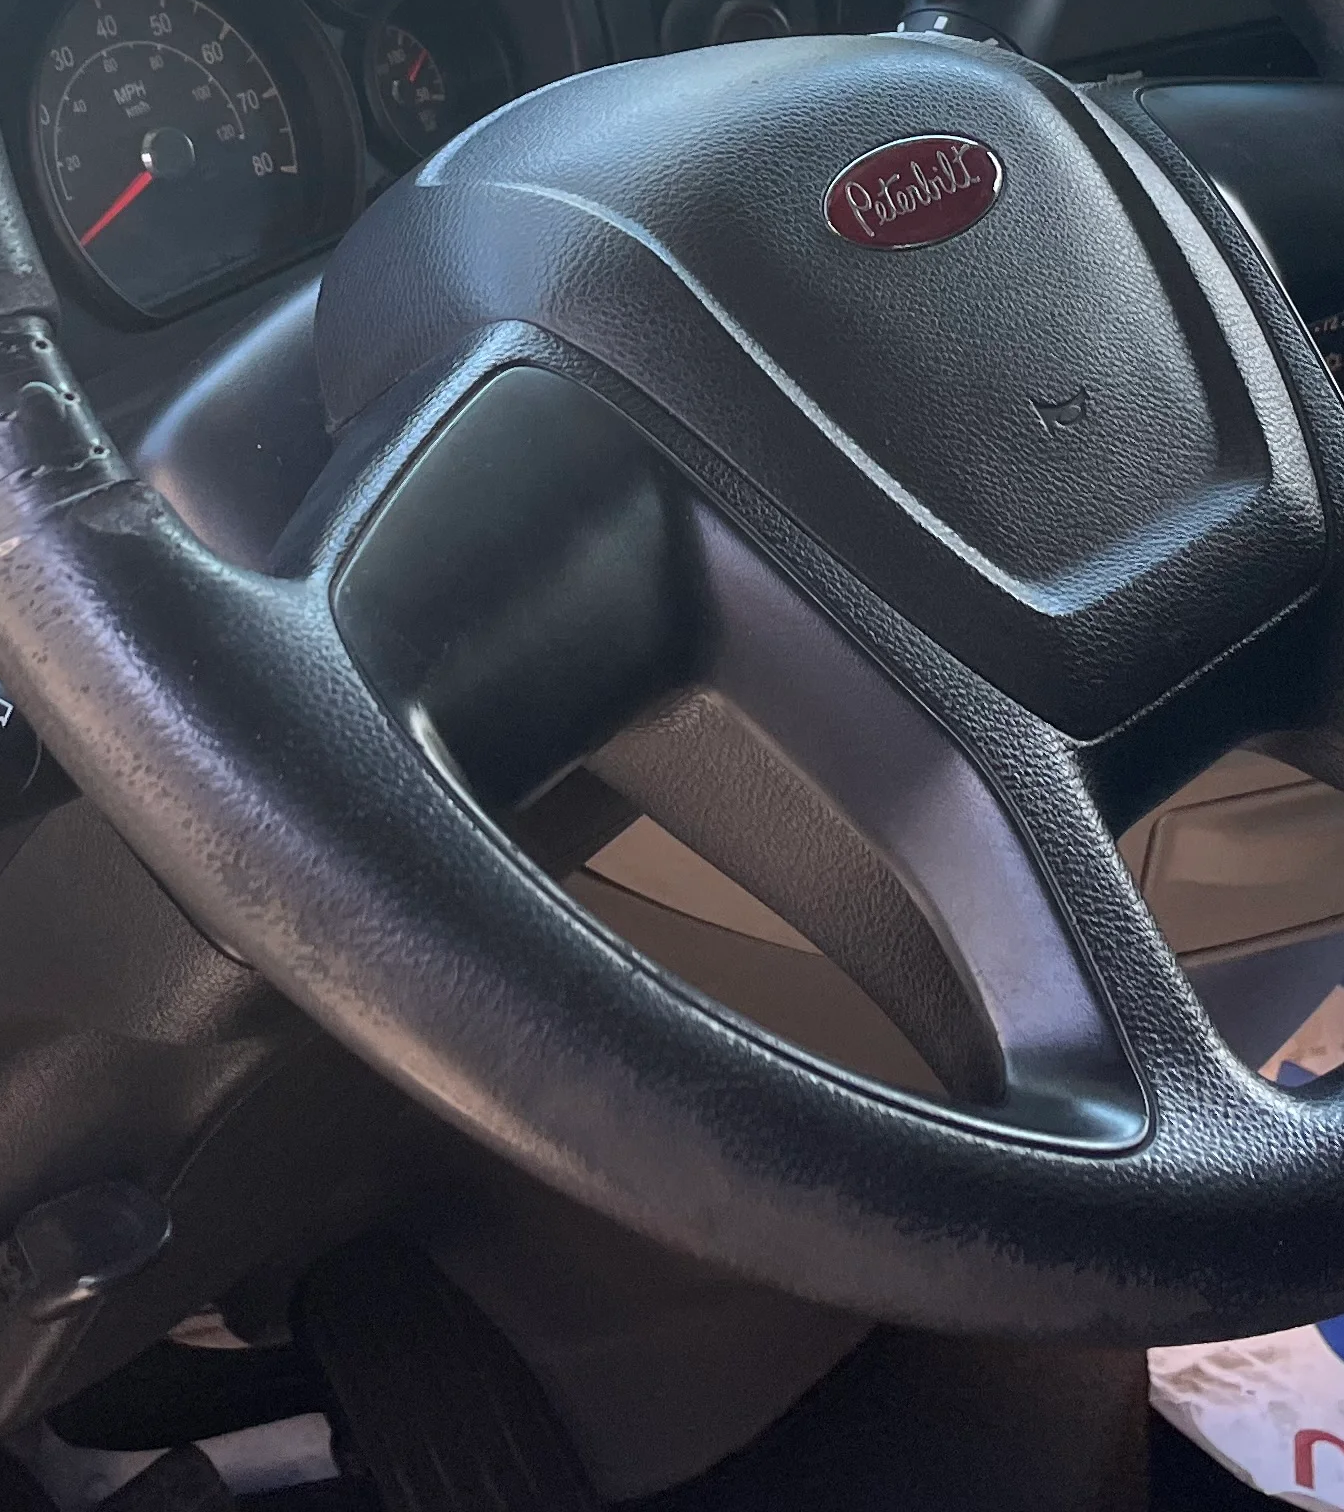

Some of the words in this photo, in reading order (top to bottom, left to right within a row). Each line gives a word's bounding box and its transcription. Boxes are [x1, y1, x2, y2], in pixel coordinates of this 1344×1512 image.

[96, 15, 118, 38] 40
[150, 13, 173, 37] 50
[51, 46, 75, 72] 30
[201, 41, 223, 65] 60
[113, 80, 146, 105] MPH
[236, 89, 260, 113] 70
[252, 151, 274, 176] 80
[844, 143, 982, 237] Peterbilt
